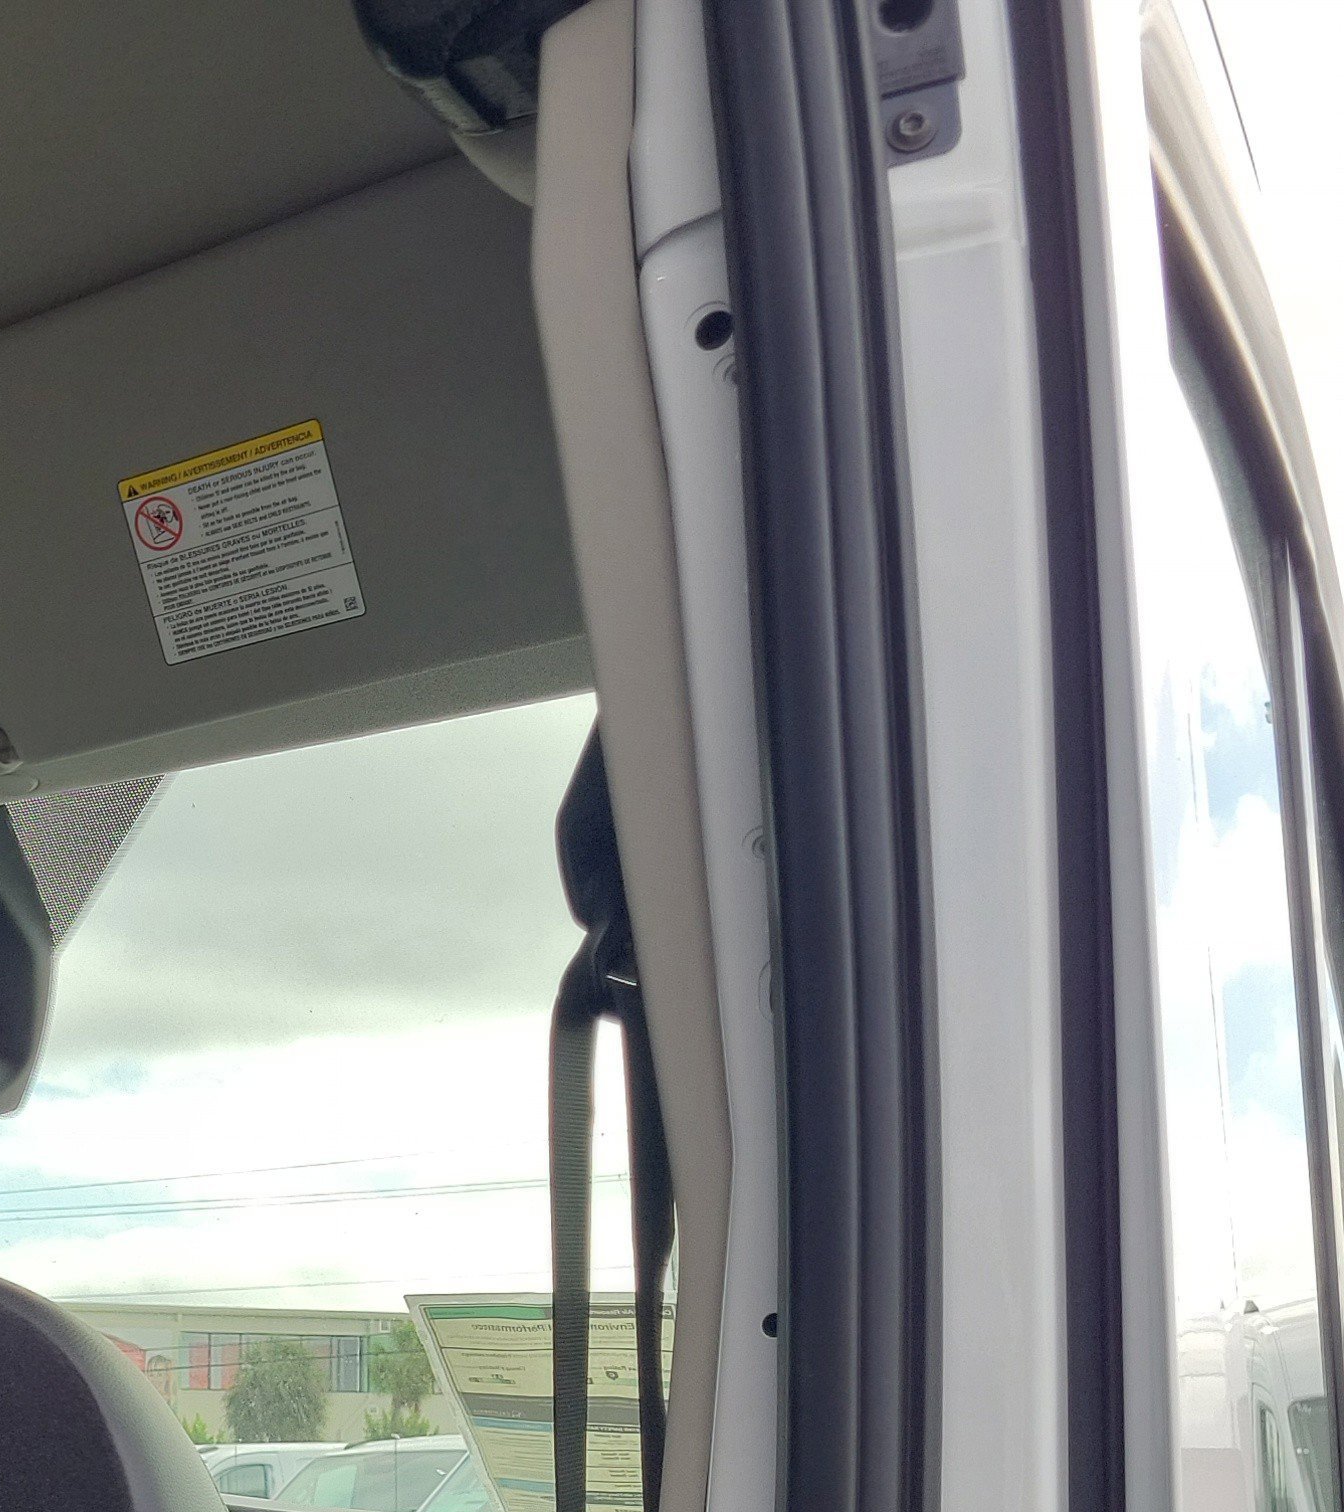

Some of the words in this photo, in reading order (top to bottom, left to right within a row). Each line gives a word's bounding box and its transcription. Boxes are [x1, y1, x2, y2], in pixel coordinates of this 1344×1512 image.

[139, 473, 177, 491] WARNING
[182, 450, 248, 478] AVERTISSEMENT
[253, 429, 312, 455] ADVERTENCIA
[187, 481, 211, 494] DEATH
